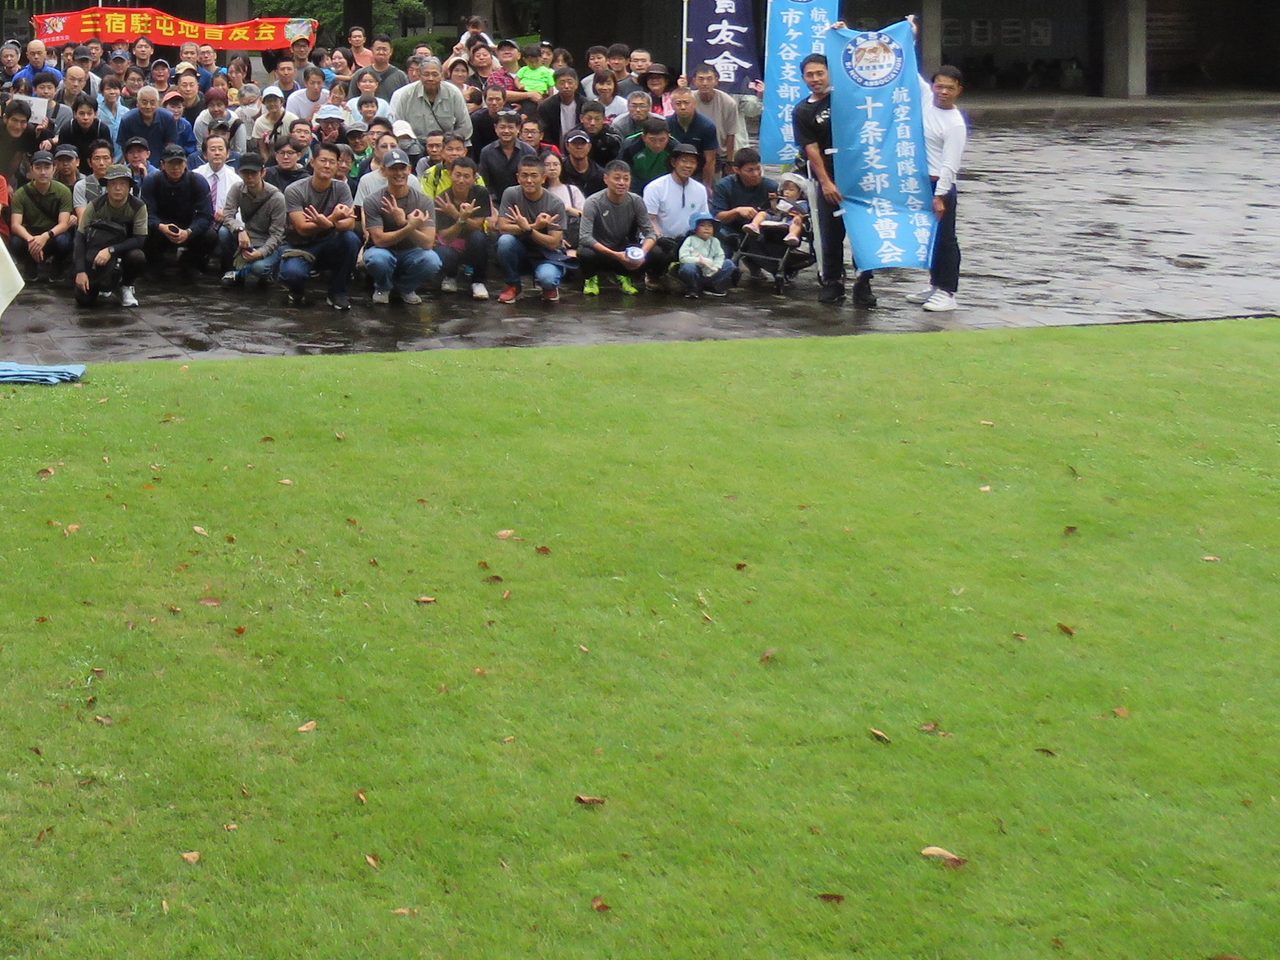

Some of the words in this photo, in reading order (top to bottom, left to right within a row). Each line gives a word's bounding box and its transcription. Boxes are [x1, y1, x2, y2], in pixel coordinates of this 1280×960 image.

[847, 32, 900, 54] JASDF
[856, 96, 906, 264] 十条支部准曹会
